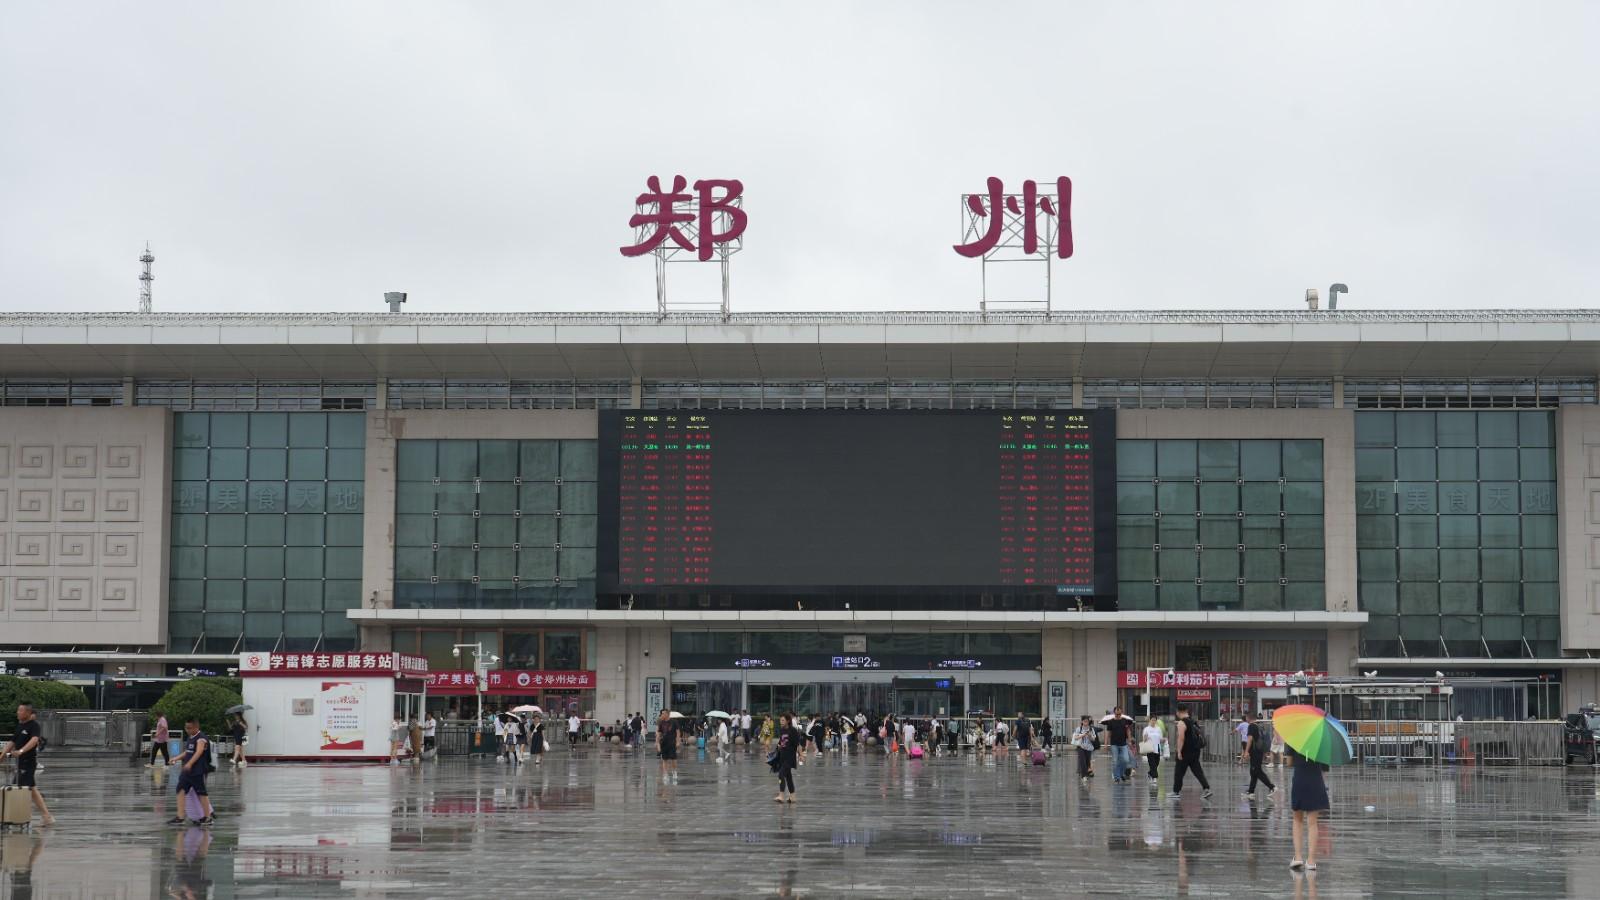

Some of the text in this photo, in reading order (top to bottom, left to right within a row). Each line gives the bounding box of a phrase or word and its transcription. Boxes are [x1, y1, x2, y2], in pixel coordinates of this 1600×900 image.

[270, 654, 393, 669] 学雷锋志愿服务站
[426, 673, 501, 685] 产美联市
[1163, 673, 1230, 686] 阿利茄汁面
